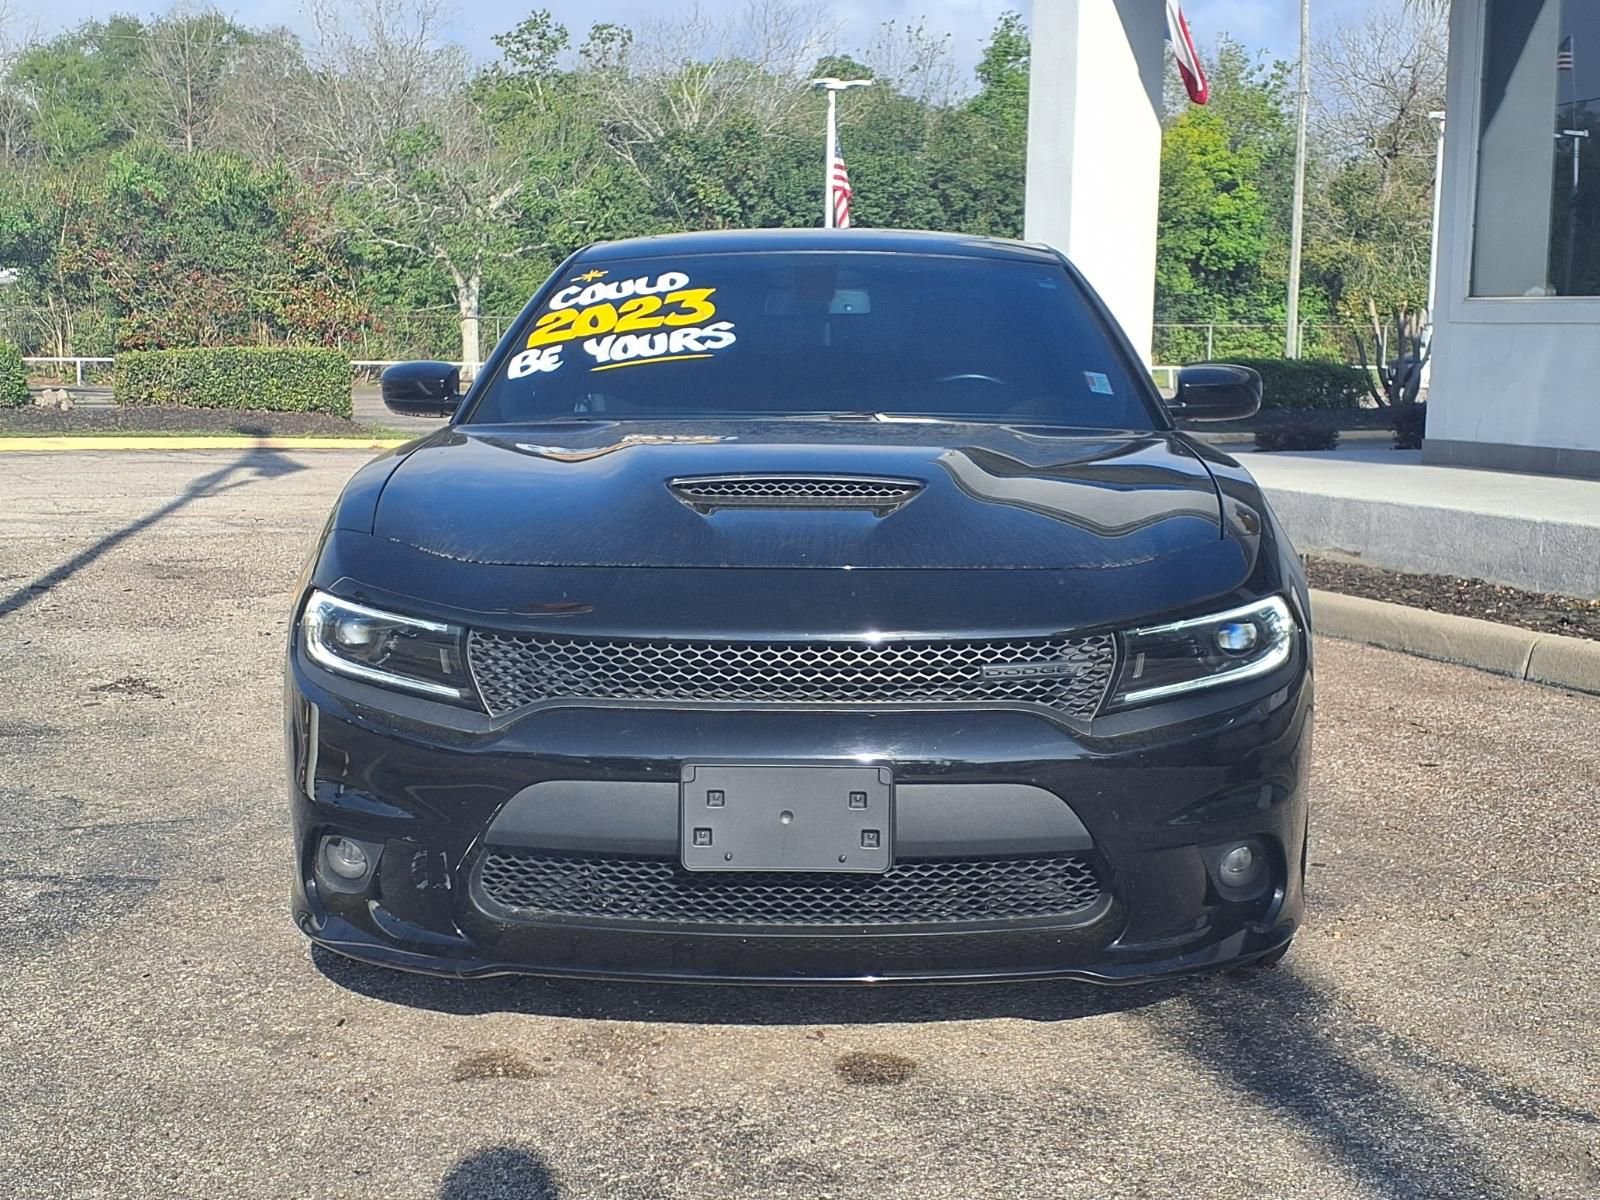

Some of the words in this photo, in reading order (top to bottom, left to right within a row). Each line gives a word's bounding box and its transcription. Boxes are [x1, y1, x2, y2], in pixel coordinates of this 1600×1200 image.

[526, 287, 717, 349] 2023
[550, 271, 690, 311] COULD
[507, 344, 564, 380] BE
[583, 321, 737, 363] YOURS
